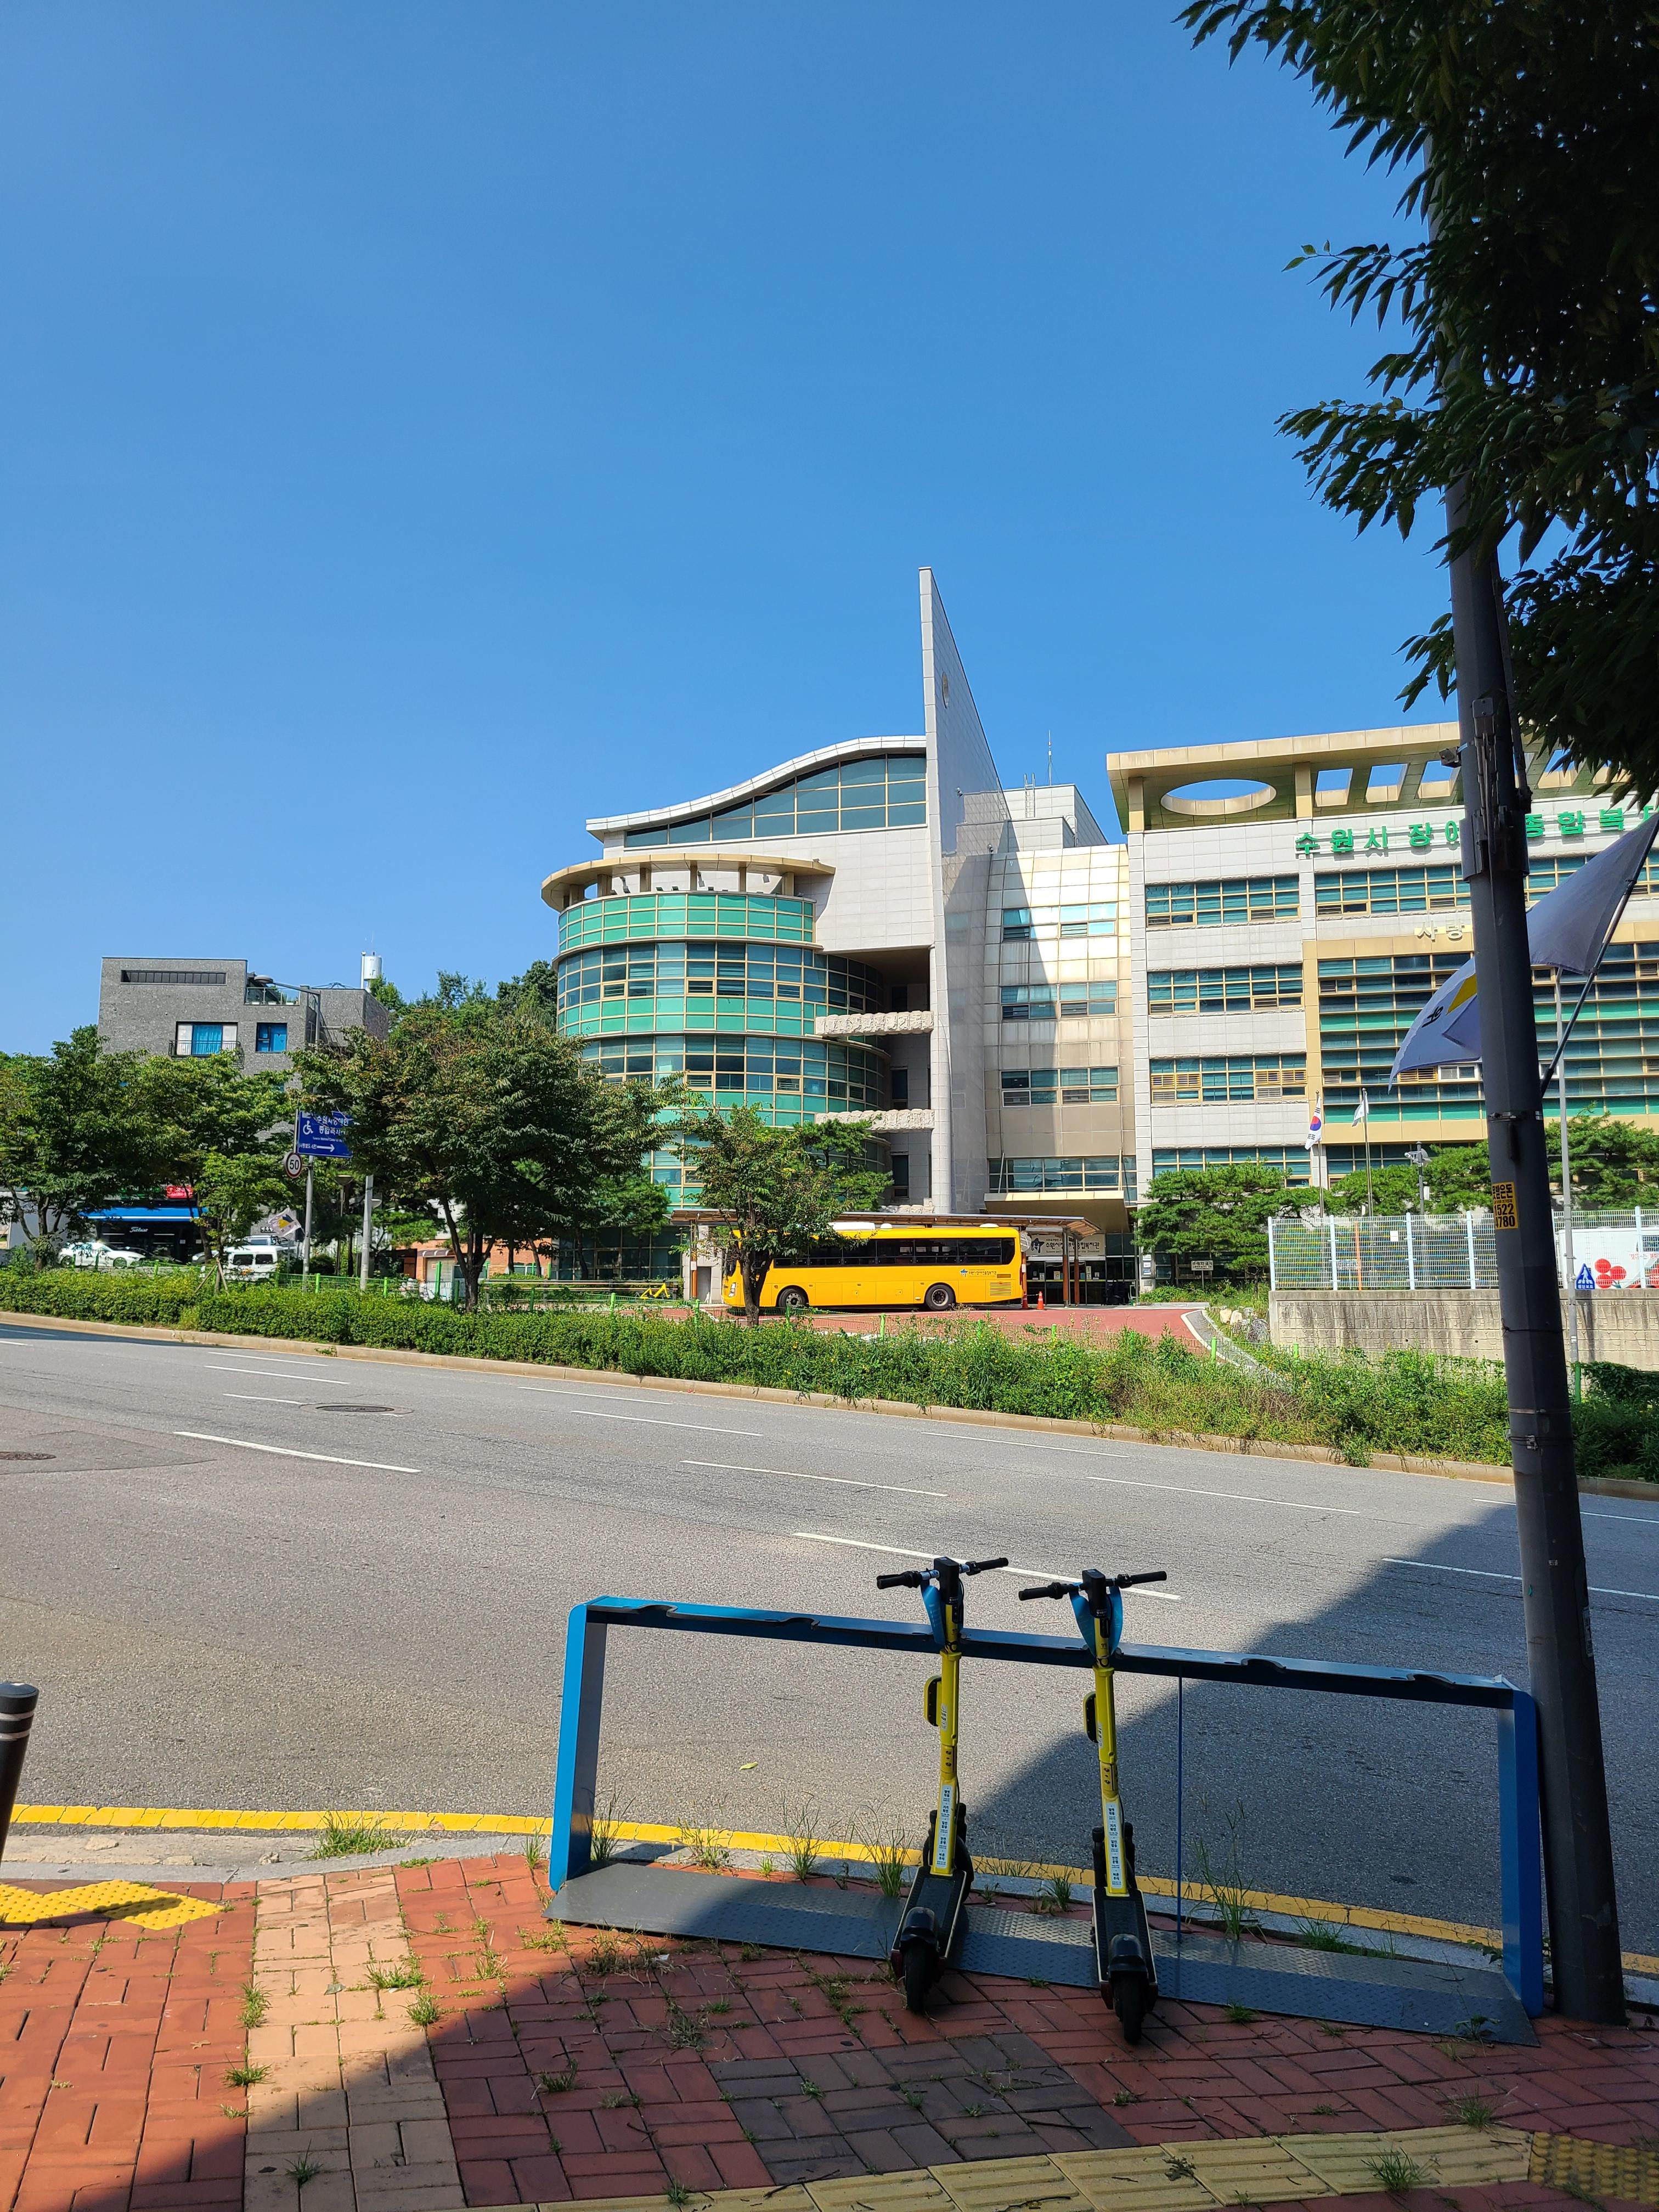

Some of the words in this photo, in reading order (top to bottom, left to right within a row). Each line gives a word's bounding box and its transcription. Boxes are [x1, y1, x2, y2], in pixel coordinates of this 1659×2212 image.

[1295, 825, 1389, 855] 수원시
[289, 1160, 300, 1170] 50
[1494, 1203, 1515, 1216] 1522
